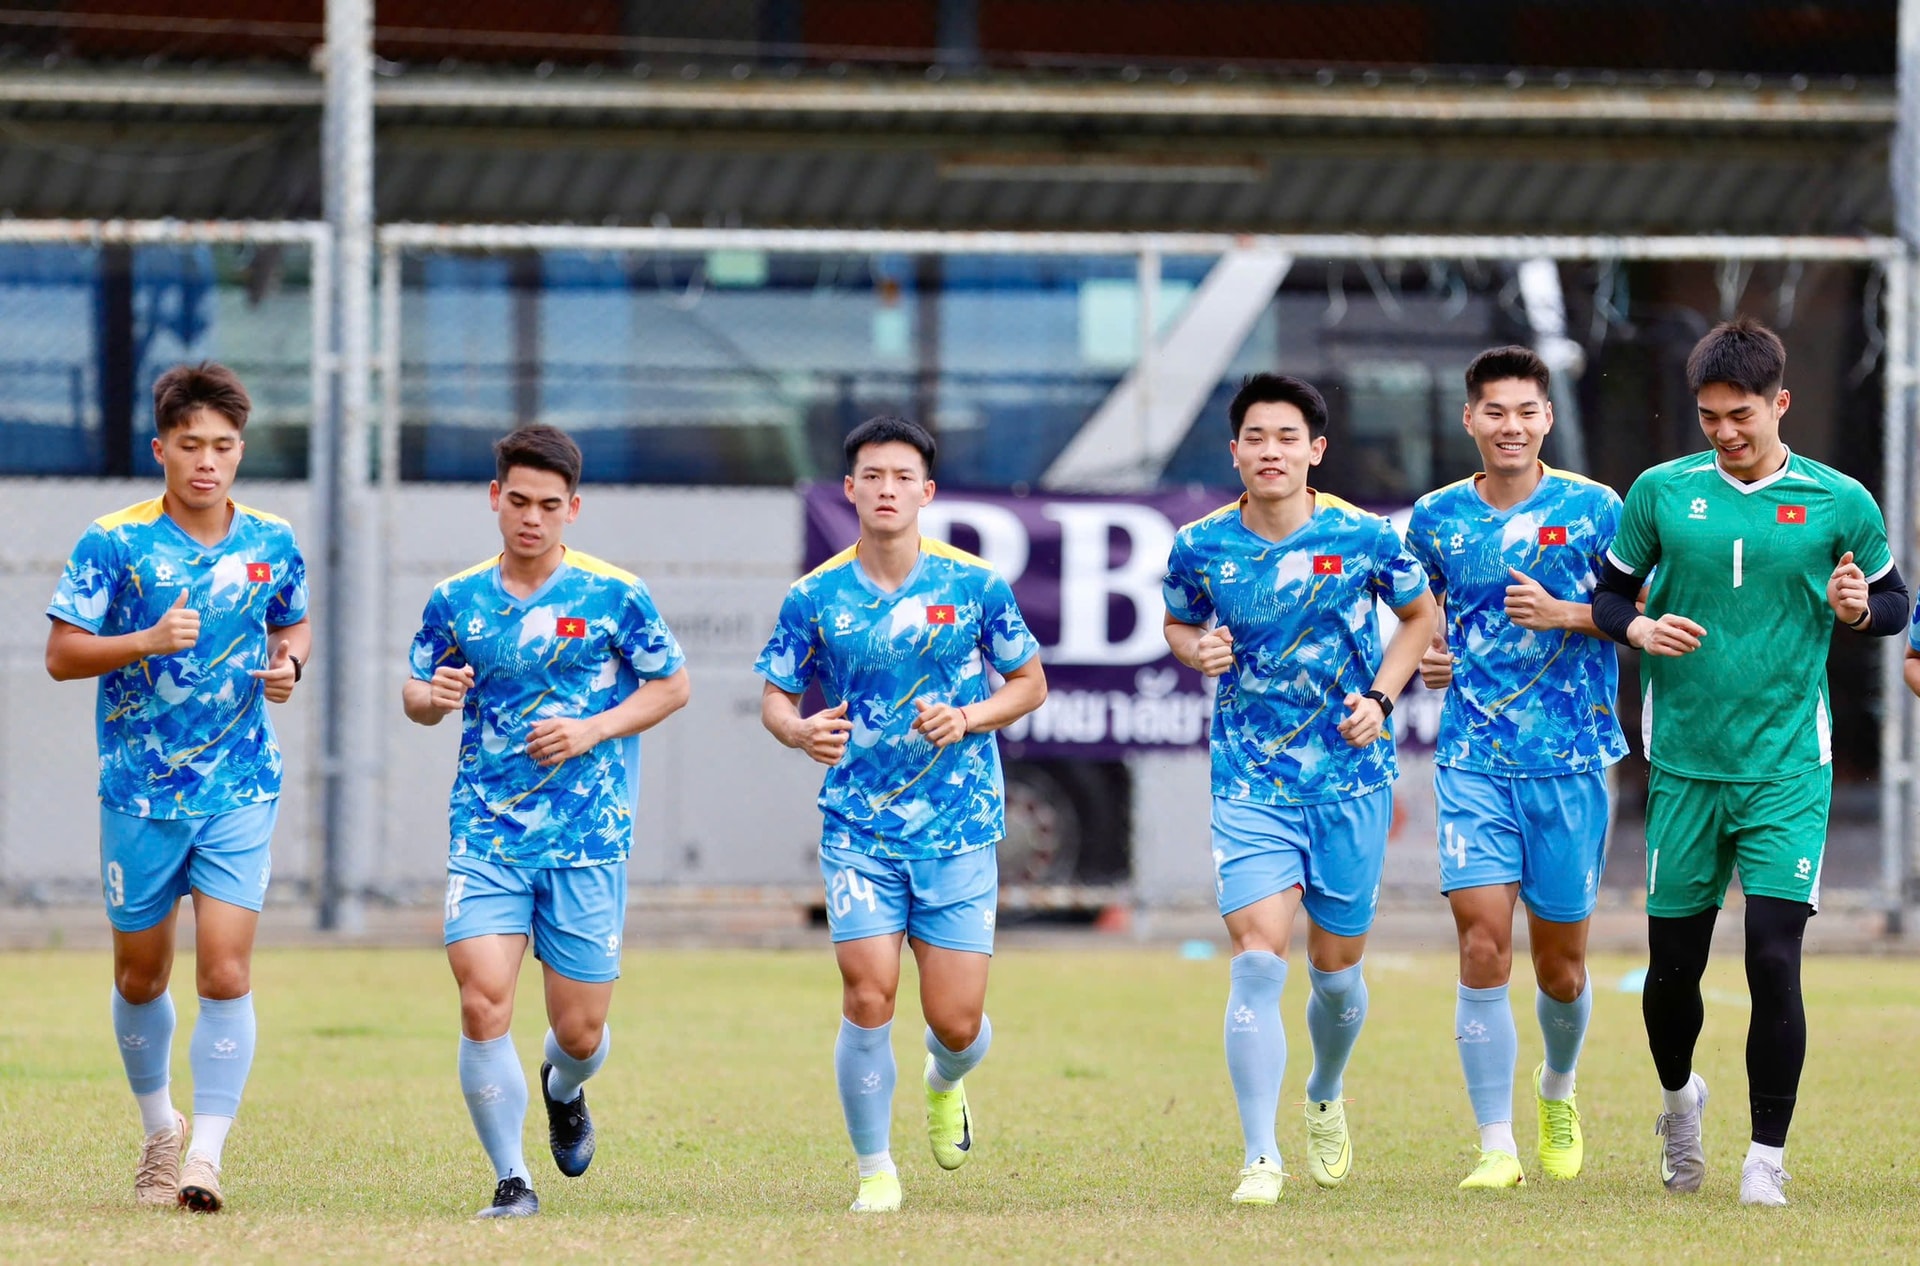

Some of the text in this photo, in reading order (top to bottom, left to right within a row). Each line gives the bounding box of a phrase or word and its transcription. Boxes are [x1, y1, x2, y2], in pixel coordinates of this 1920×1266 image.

[1733, 537, 1743, 589] 1
[1444, 822, 1466, 869] 4
[107, 861, 125, 907] 9
[831, 867, 877, 919] 24
